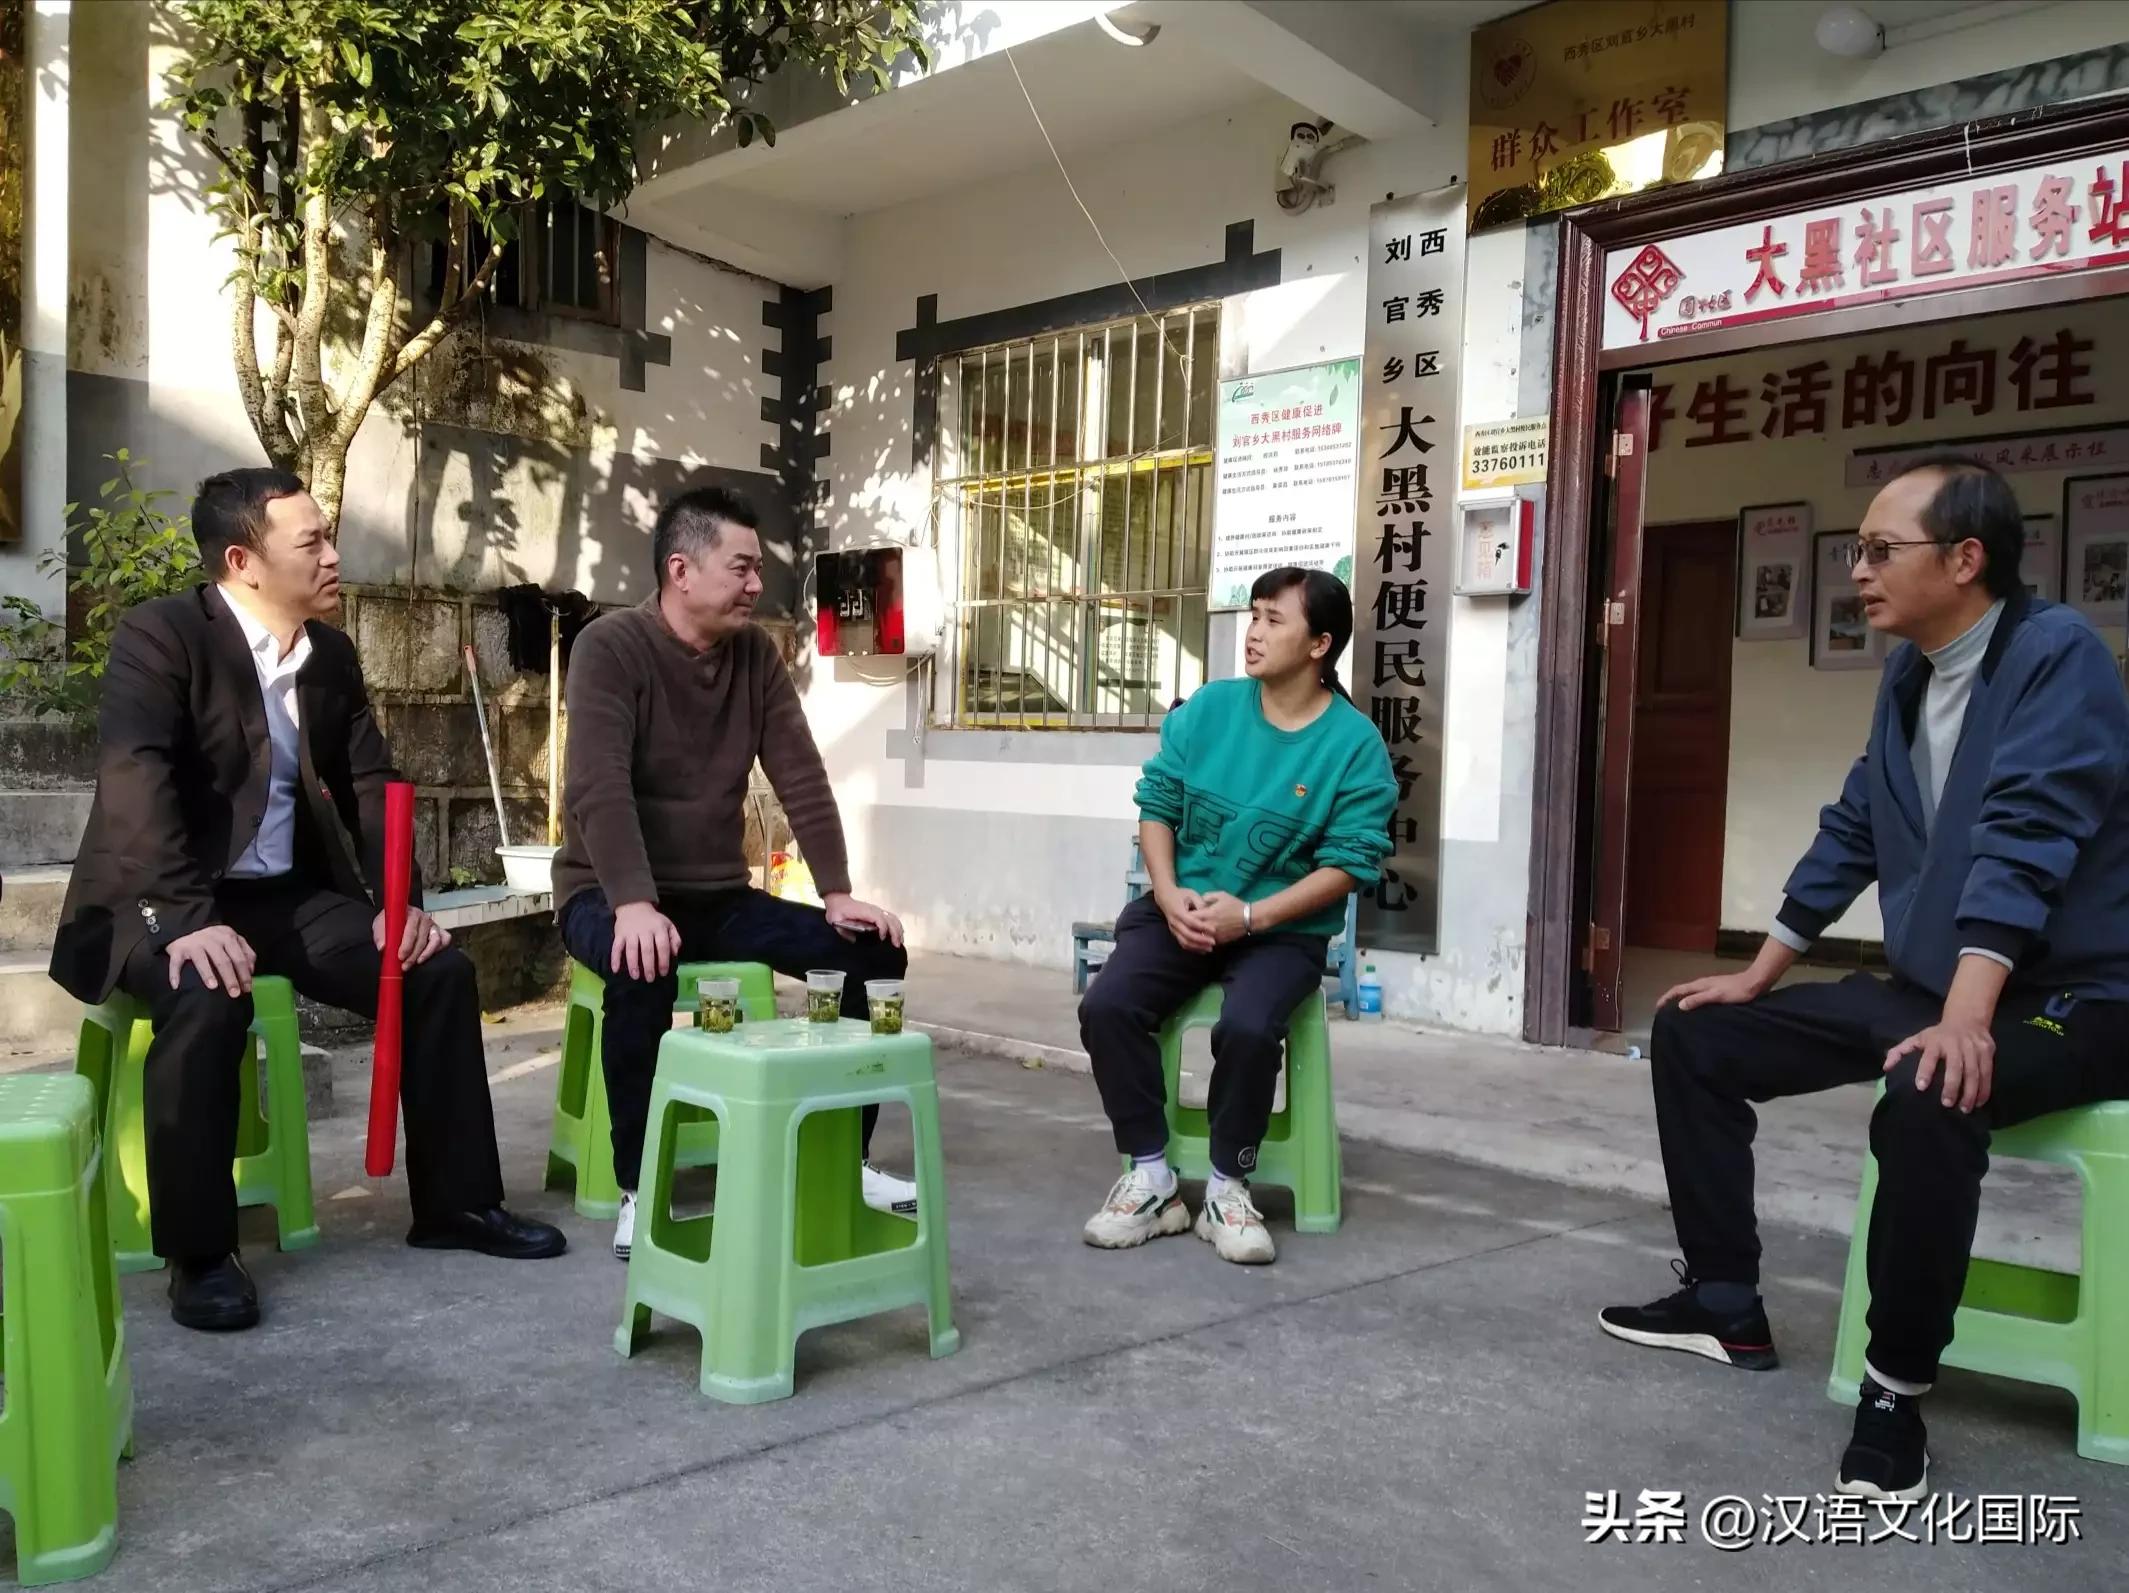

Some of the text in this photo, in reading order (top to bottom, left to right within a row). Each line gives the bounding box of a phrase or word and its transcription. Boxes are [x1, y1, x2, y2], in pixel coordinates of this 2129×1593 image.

[1491, 86, 1692, 171] 群众工作室
[1744, 161, 2129, 300] 大黑社区服务站
[1381, 234, 1412, 384] 刘官乡
[1414, 227, 1448, 378] 西秀区
[1472, 453, 1544, 474] 33760111
[1473, 438, 1546, 456] 效能监察投诉电话
